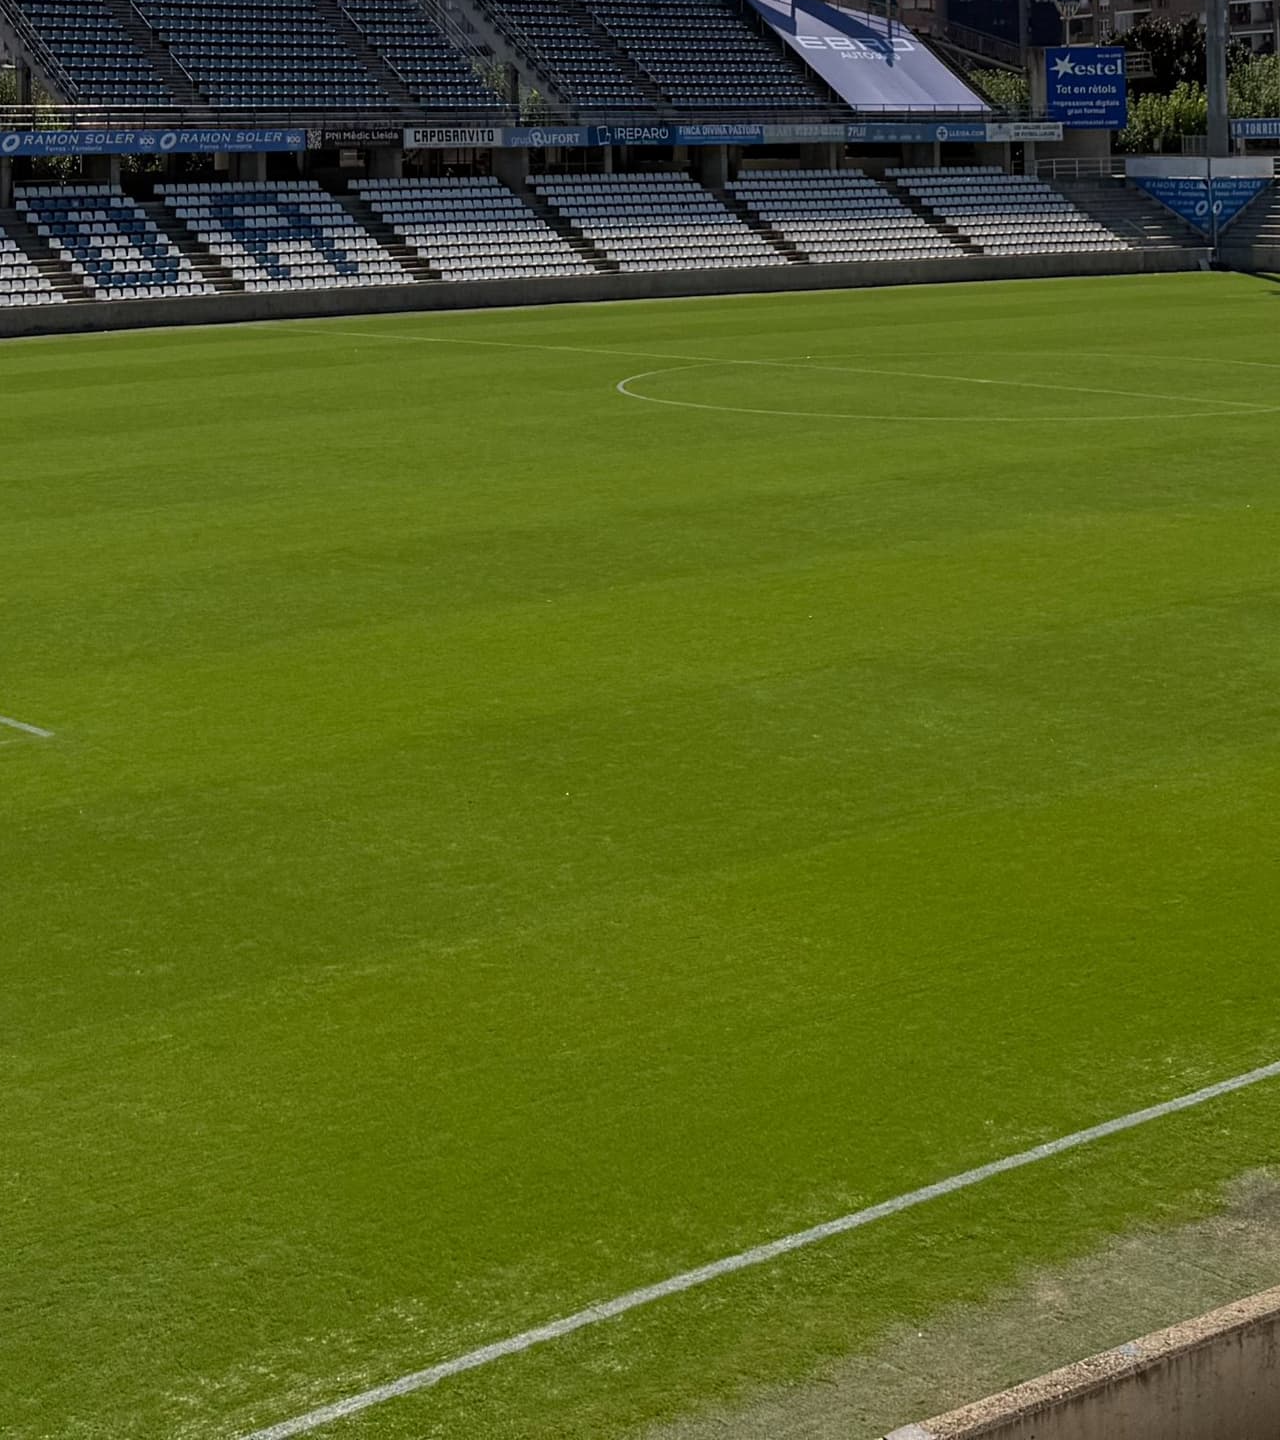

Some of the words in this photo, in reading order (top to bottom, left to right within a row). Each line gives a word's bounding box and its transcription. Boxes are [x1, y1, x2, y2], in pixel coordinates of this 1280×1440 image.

[1074, 59, 1122, 75] estel
[1056, 85, 1071, 94] Tot
[23, 134, 80, 145] RAMON
[85, 133, 135, 144] SOLER
[180, 133, 231, 143] RAMON
[236, 132, 282, 142] SOLER
[414, 128, 495, 143] CAPOSANVITO
